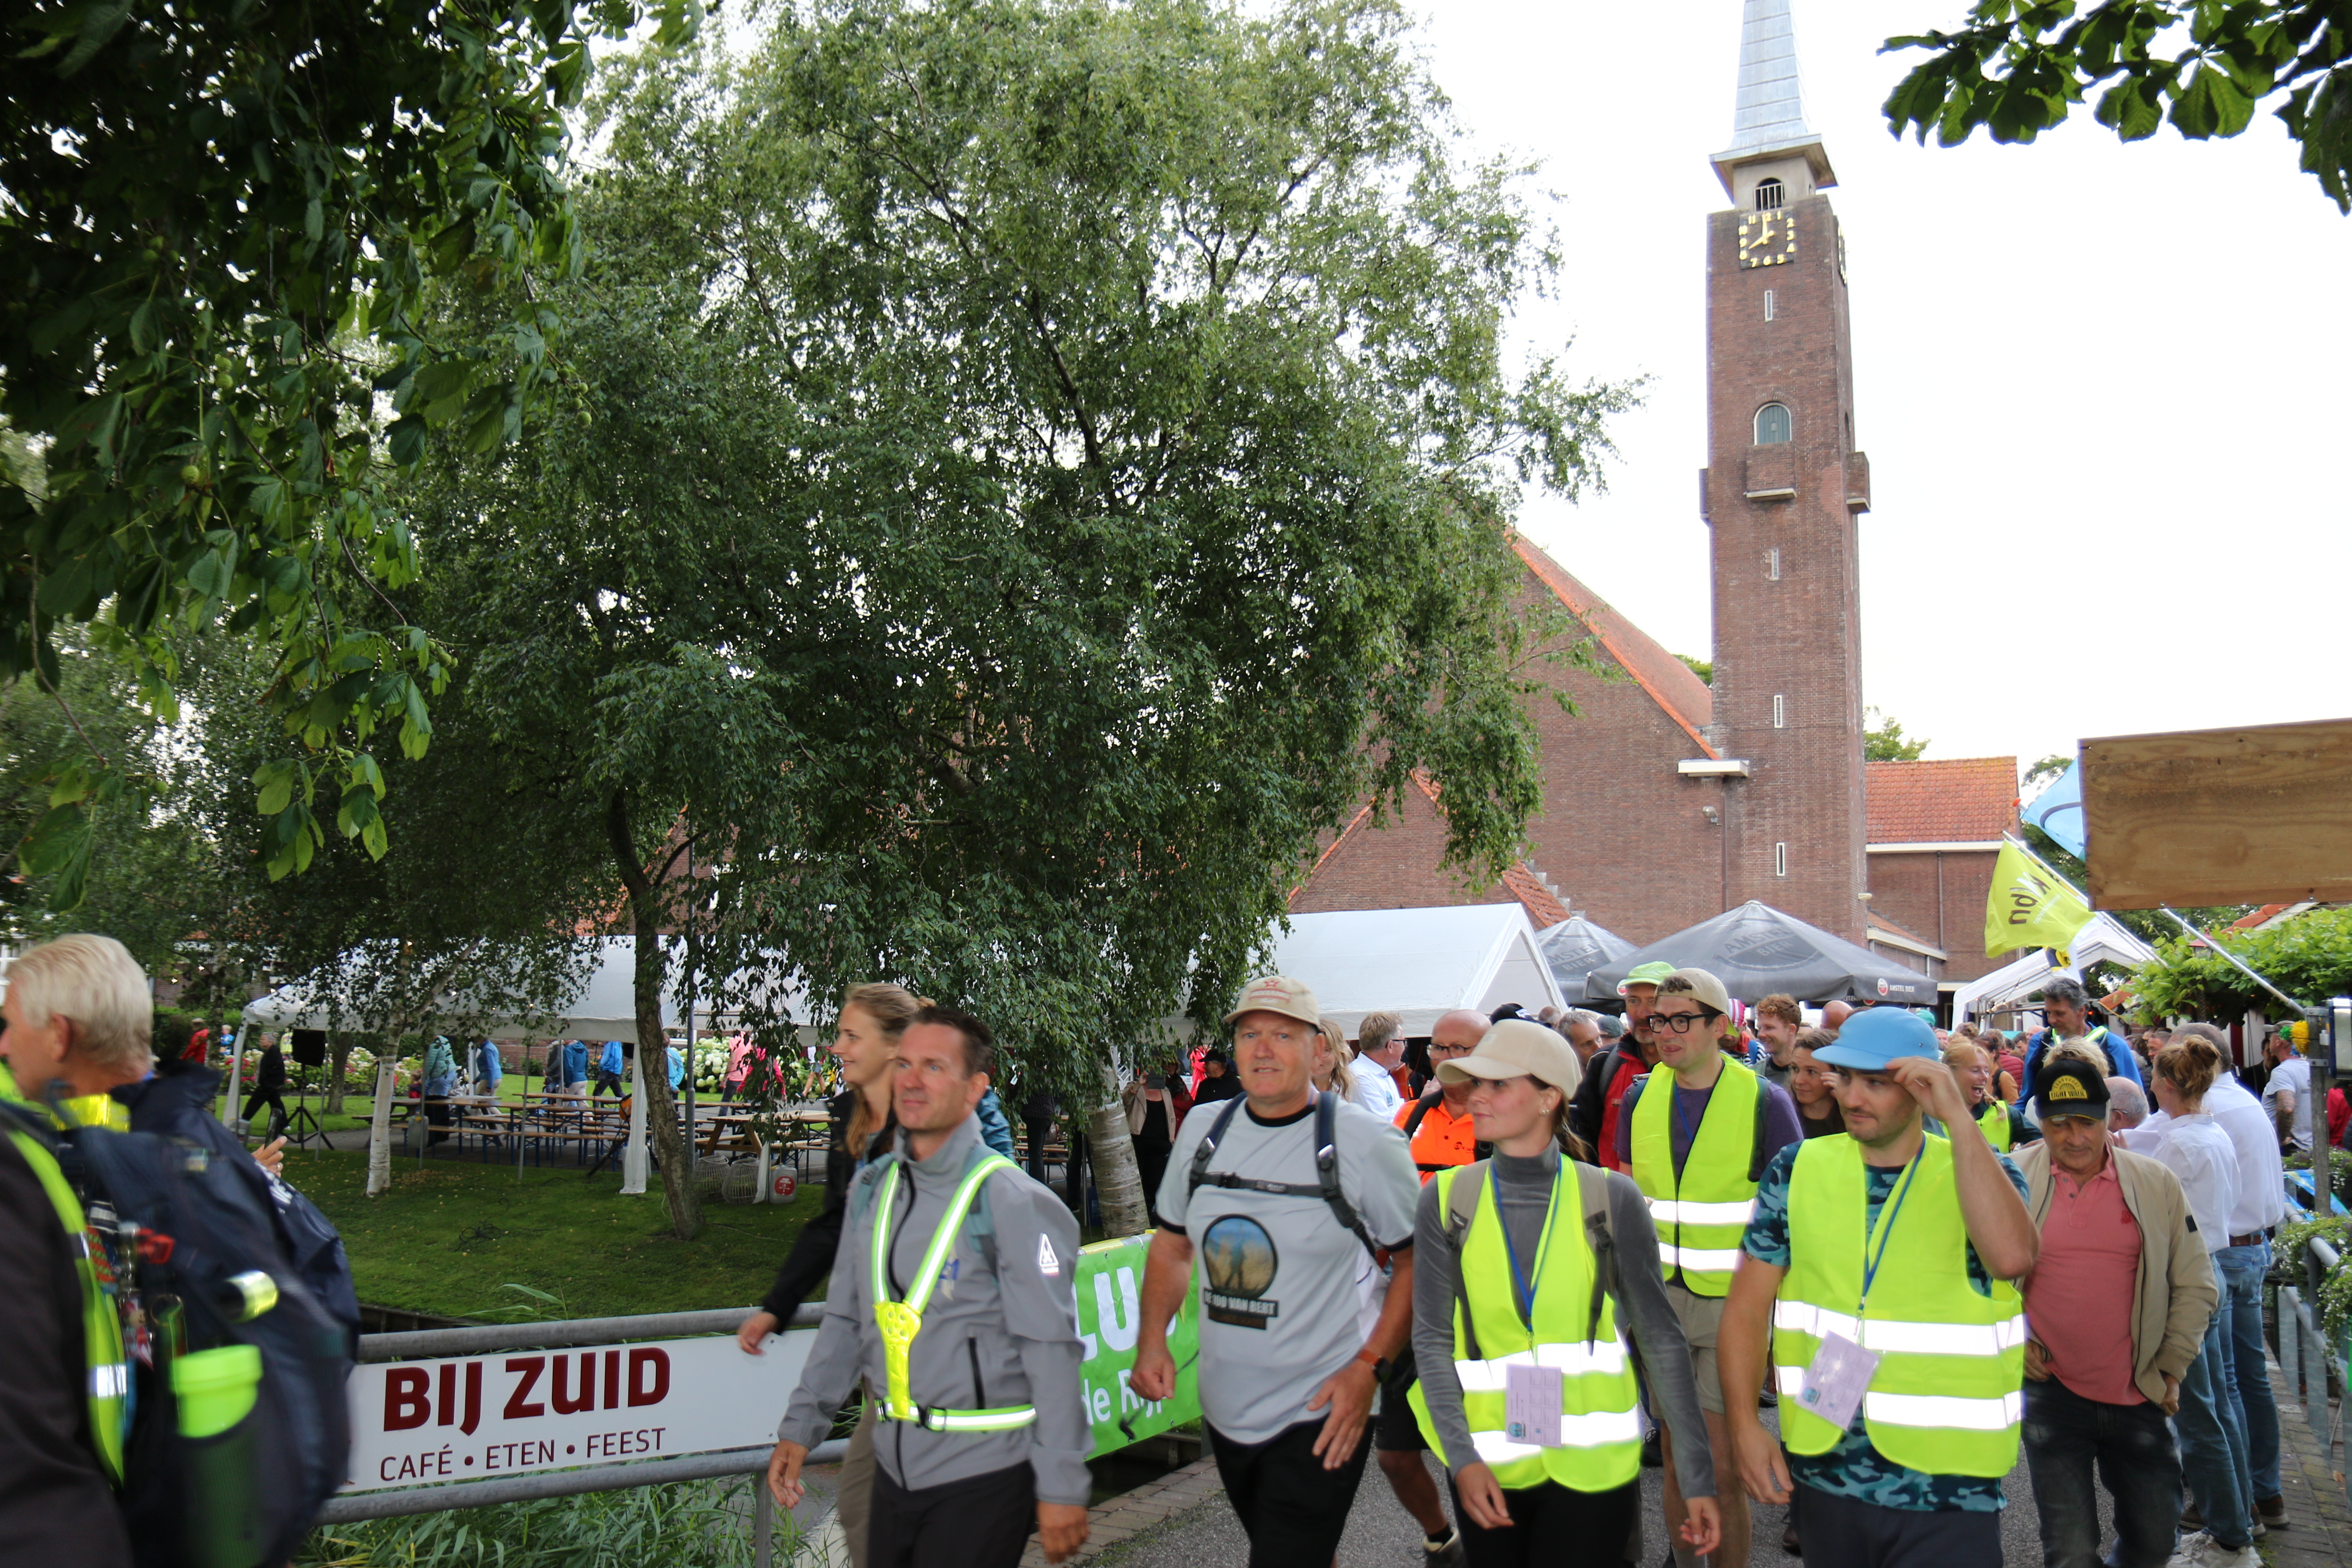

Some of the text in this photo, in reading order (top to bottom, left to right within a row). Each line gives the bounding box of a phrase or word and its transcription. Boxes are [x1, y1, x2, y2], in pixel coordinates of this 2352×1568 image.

[1748, 214, 1756, 224] 11
[1762, 212, 1772, 222] 2
[1777, 210, 1782, 220] 1
[1786, 217, 1795, 228] 2
[1738, 225, 1748, 236] 10
[1787, 230, 1795, 240] 3
[1739, 238, 1747, 248] 9
[1786, 242, 1795, 253] 4
[1739, 250, 1747, 260] 8
[1763, 255, 1771, 266] 6
[1776, 254, 1785, 264] 5
[1750, 257, 1758, 267] 7
[1723, 928, 1795, 953] AMSTEL
[1756, 941, 1793, 956] BIER
[1562, 957, 1596, 971] BIER
[1889, 984, 1905, 992] AMSTEL
[1212, 1293, 1227, 1308] 100
[1228, 1296, 1248, 1311] VAN
[1249, 1300, 1276, 1315] BERT
[383, 1347, 670, 1436] BIJ ZUID
[380, 1427, 666, 1481] CAFÉ ETEN FEEST
